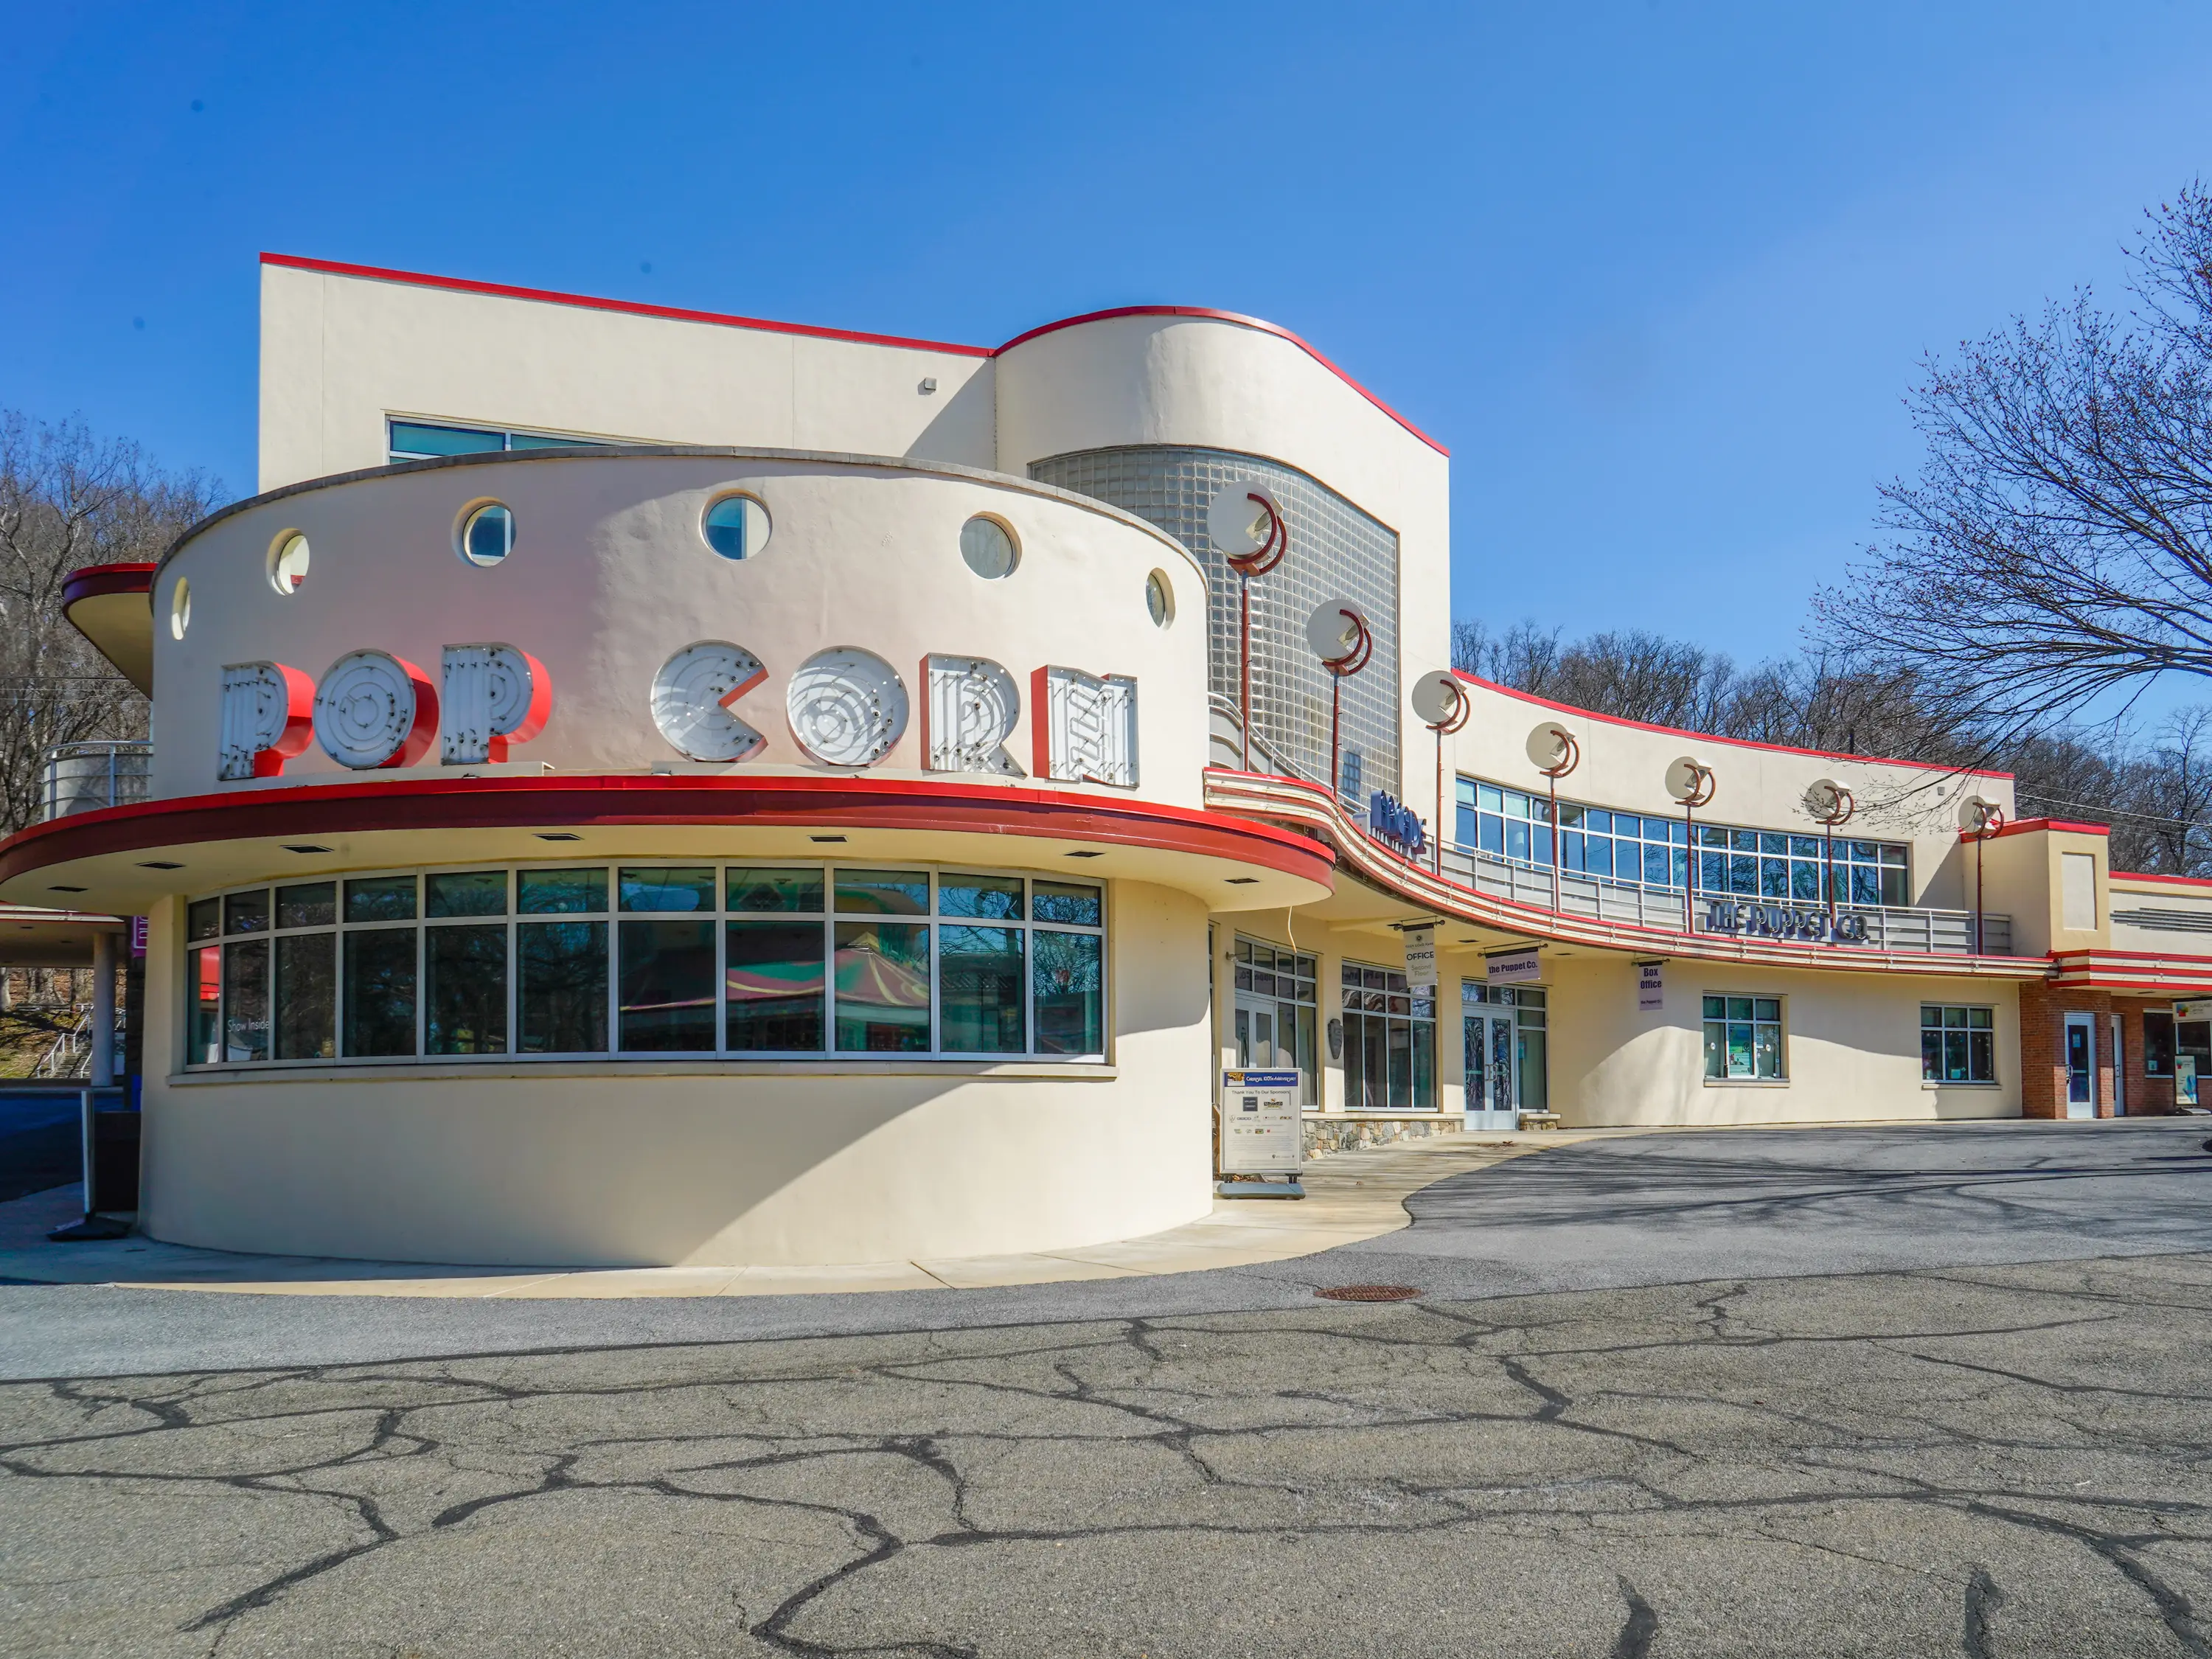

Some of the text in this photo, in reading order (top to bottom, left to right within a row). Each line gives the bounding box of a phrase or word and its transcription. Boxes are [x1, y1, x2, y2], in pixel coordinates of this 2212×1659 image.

[218, 639, 1140, 787] POP CORN
[1711, 901, 1747, 929] THE
[1752, 904, 1832, 936] PUPPET
[1407, 951, 1434, 961] OFFICE
[1489, 961, 1538, 974] the Puppet Co.
[1644, 967, 1658, 977] Box
[1640, 980, 1662, 990] Office
[228, 1019, 246, 1032] Show
[248, 1016, 269, 1031] Inside
